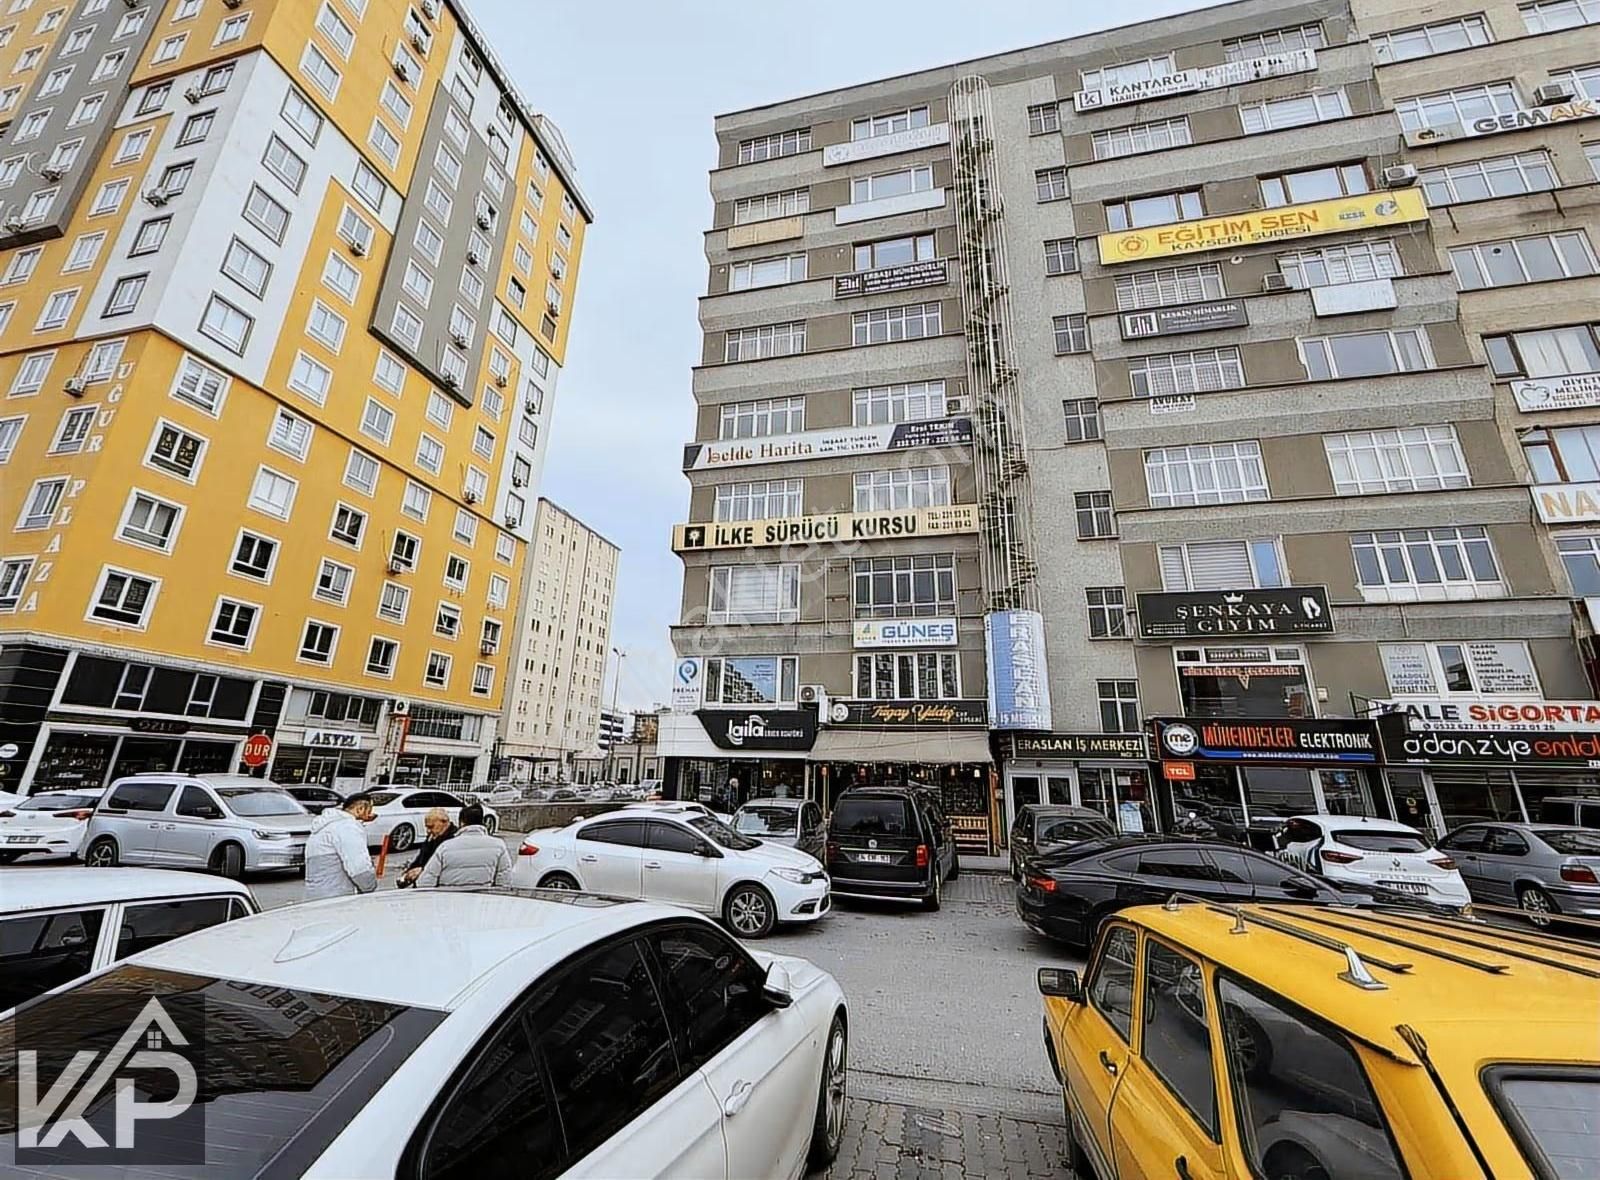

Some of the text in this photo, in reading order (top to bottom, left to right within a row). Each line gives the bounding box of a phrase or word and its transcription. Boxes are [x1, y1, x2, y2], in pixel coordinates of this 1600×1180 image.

[1110, 73, 1188, 96] KANTARCI
[1473, 101, 1597, 133] GEMAK
[1158, 210, 1320, 245] EĞİTİM SEN
[761, 441, 812, 458] Harita
[1540, 490, 1600, 518] NA
[715, 515, 917, 546] İLKE SÜRÜCÜ KURSU
[20, 479, 87, 613] PLAZA
[1176, 602, 1294, 620] ŞENKAYA
[882, 621, 954, 642] GÜNEŞ
[1197, 618, 1276, 633] GİYİM
[244, 743, 270, 756] DUR
[310, 733, 357, 747] AKYEL
[1018, 739, 1072, 750] ERASLAN
[1168, 768, 1190, 776] TCL
